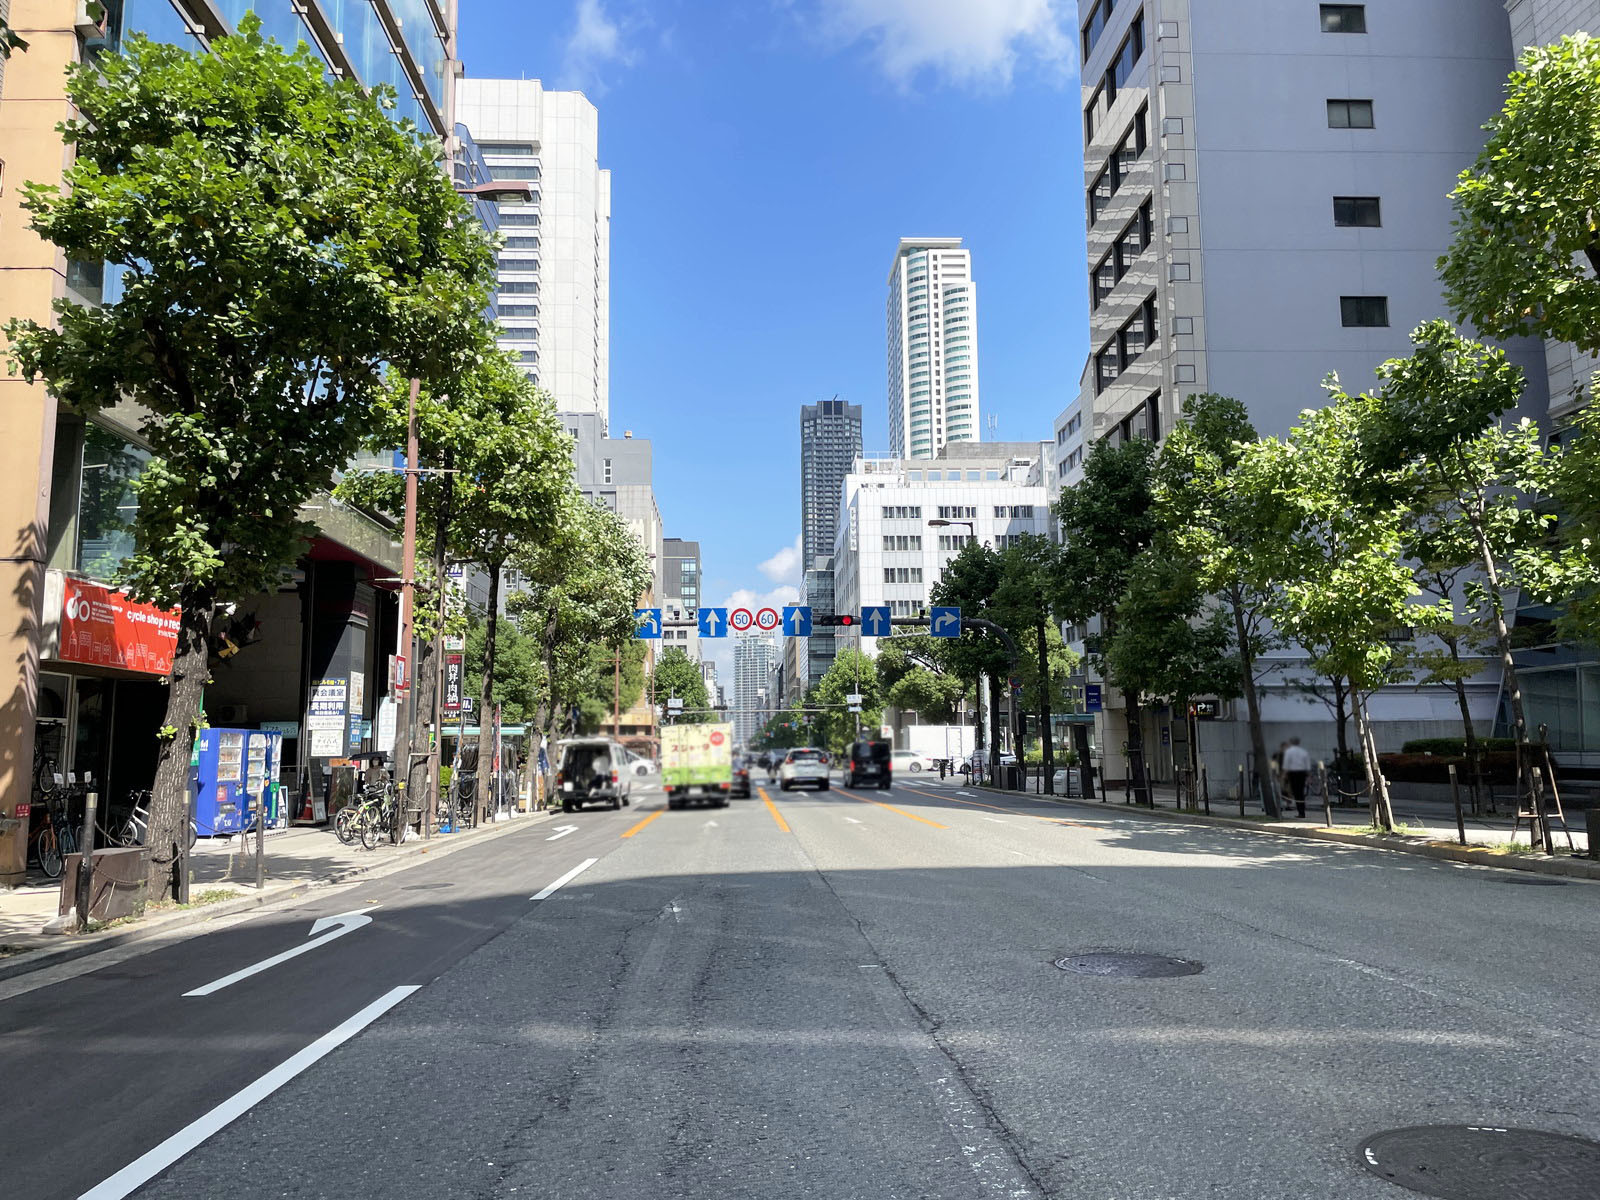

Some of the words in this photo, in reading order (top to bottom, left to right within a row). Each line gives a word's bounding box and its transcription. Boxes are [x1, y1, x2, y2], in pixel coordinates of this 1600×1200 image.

[127, 610, 146, 623] cycle
[147, 613, 163, 628] shop
[735, 614, 748, 625] 50
[761, 614, 774, 625] 60
[311, 701, 344, 711] 長期利用
